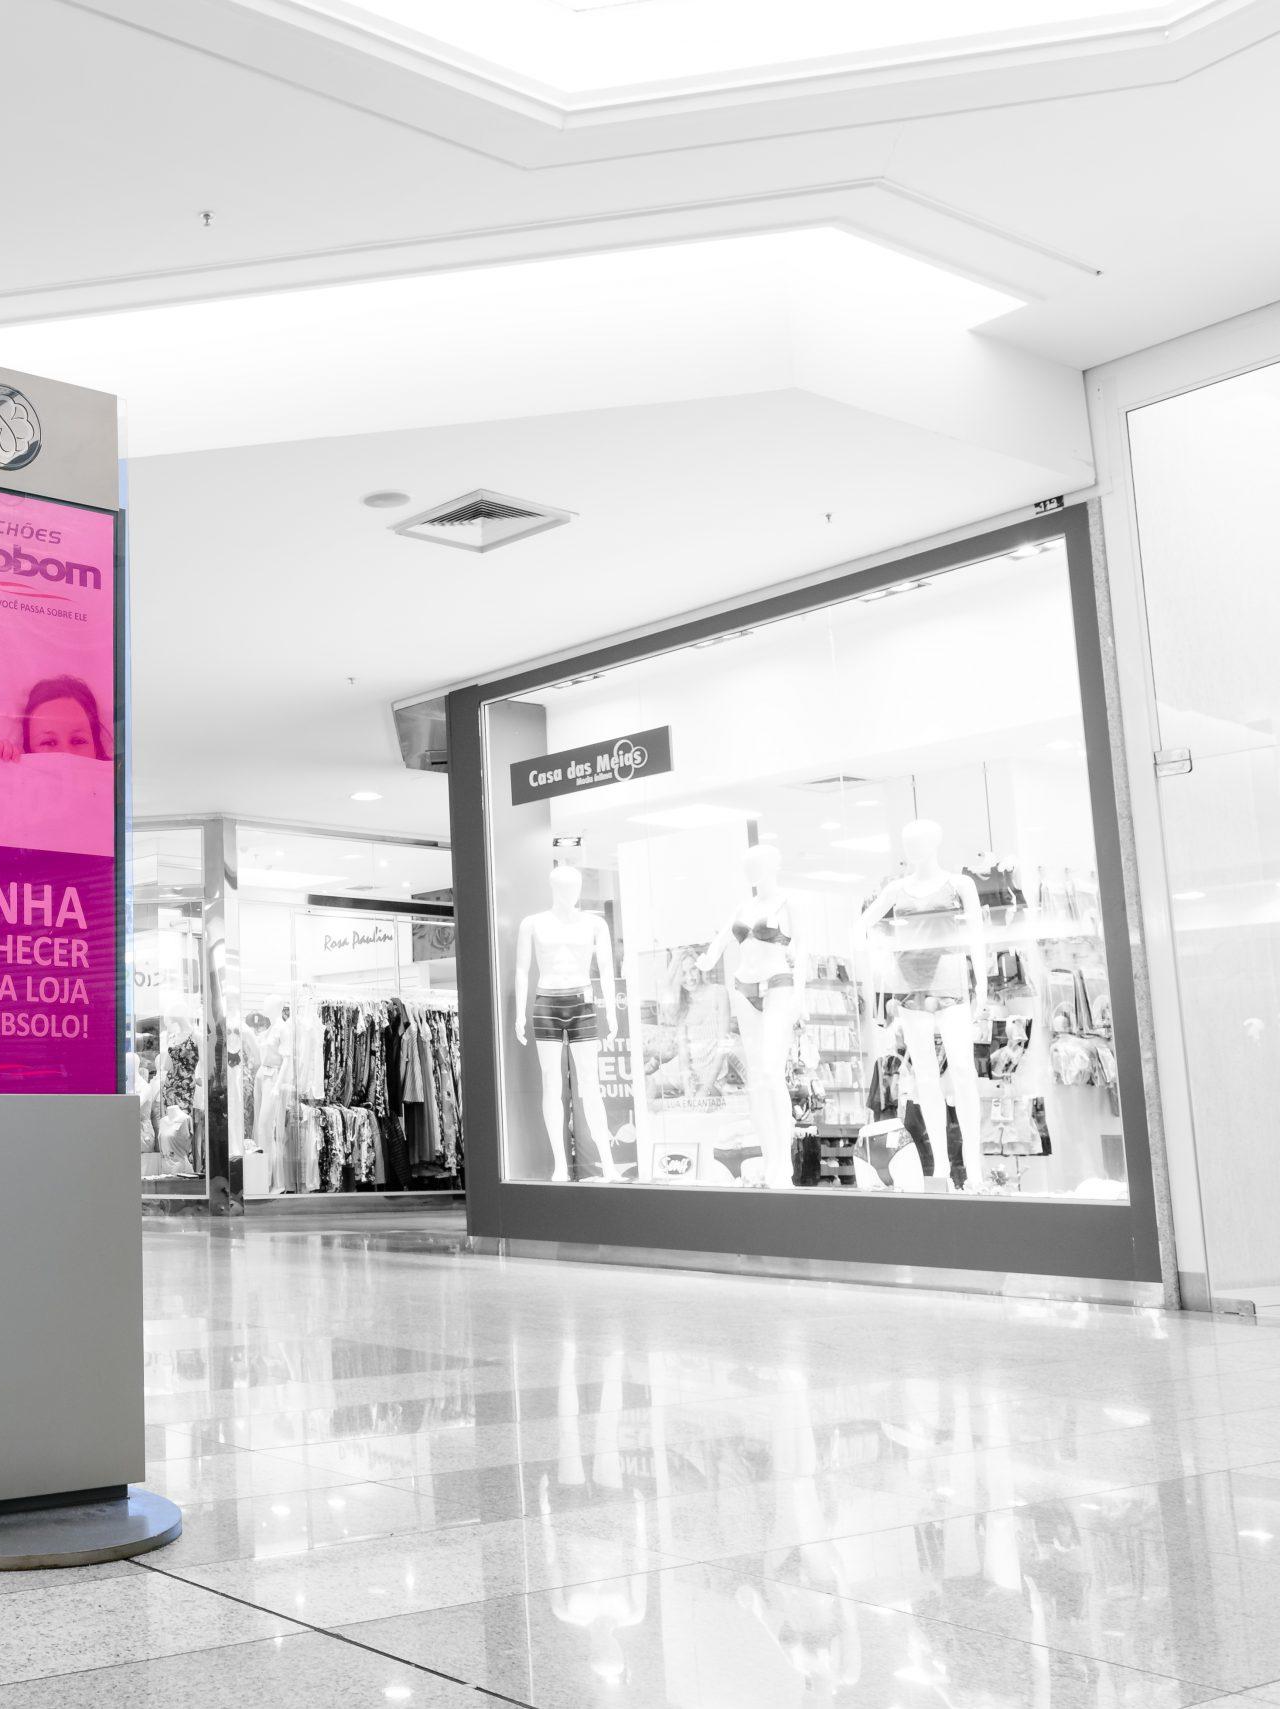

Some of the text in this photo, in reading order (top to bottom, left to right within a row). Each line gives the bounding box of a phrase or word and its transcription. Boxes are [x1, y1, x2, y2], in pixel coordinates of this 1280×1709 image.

[20, 603, 45, 614] PASSA
[47, 607, 73, 620] SOBRE
[74, 612, 88, 622] ELE
[528, 768, 563, 787] Casa
[566, 760, 592, 780] das
[596, 750, 642, 773] Meias
[324, 934, 350, 952] Rosa
[26, 975, 90, 1005] LOJA
